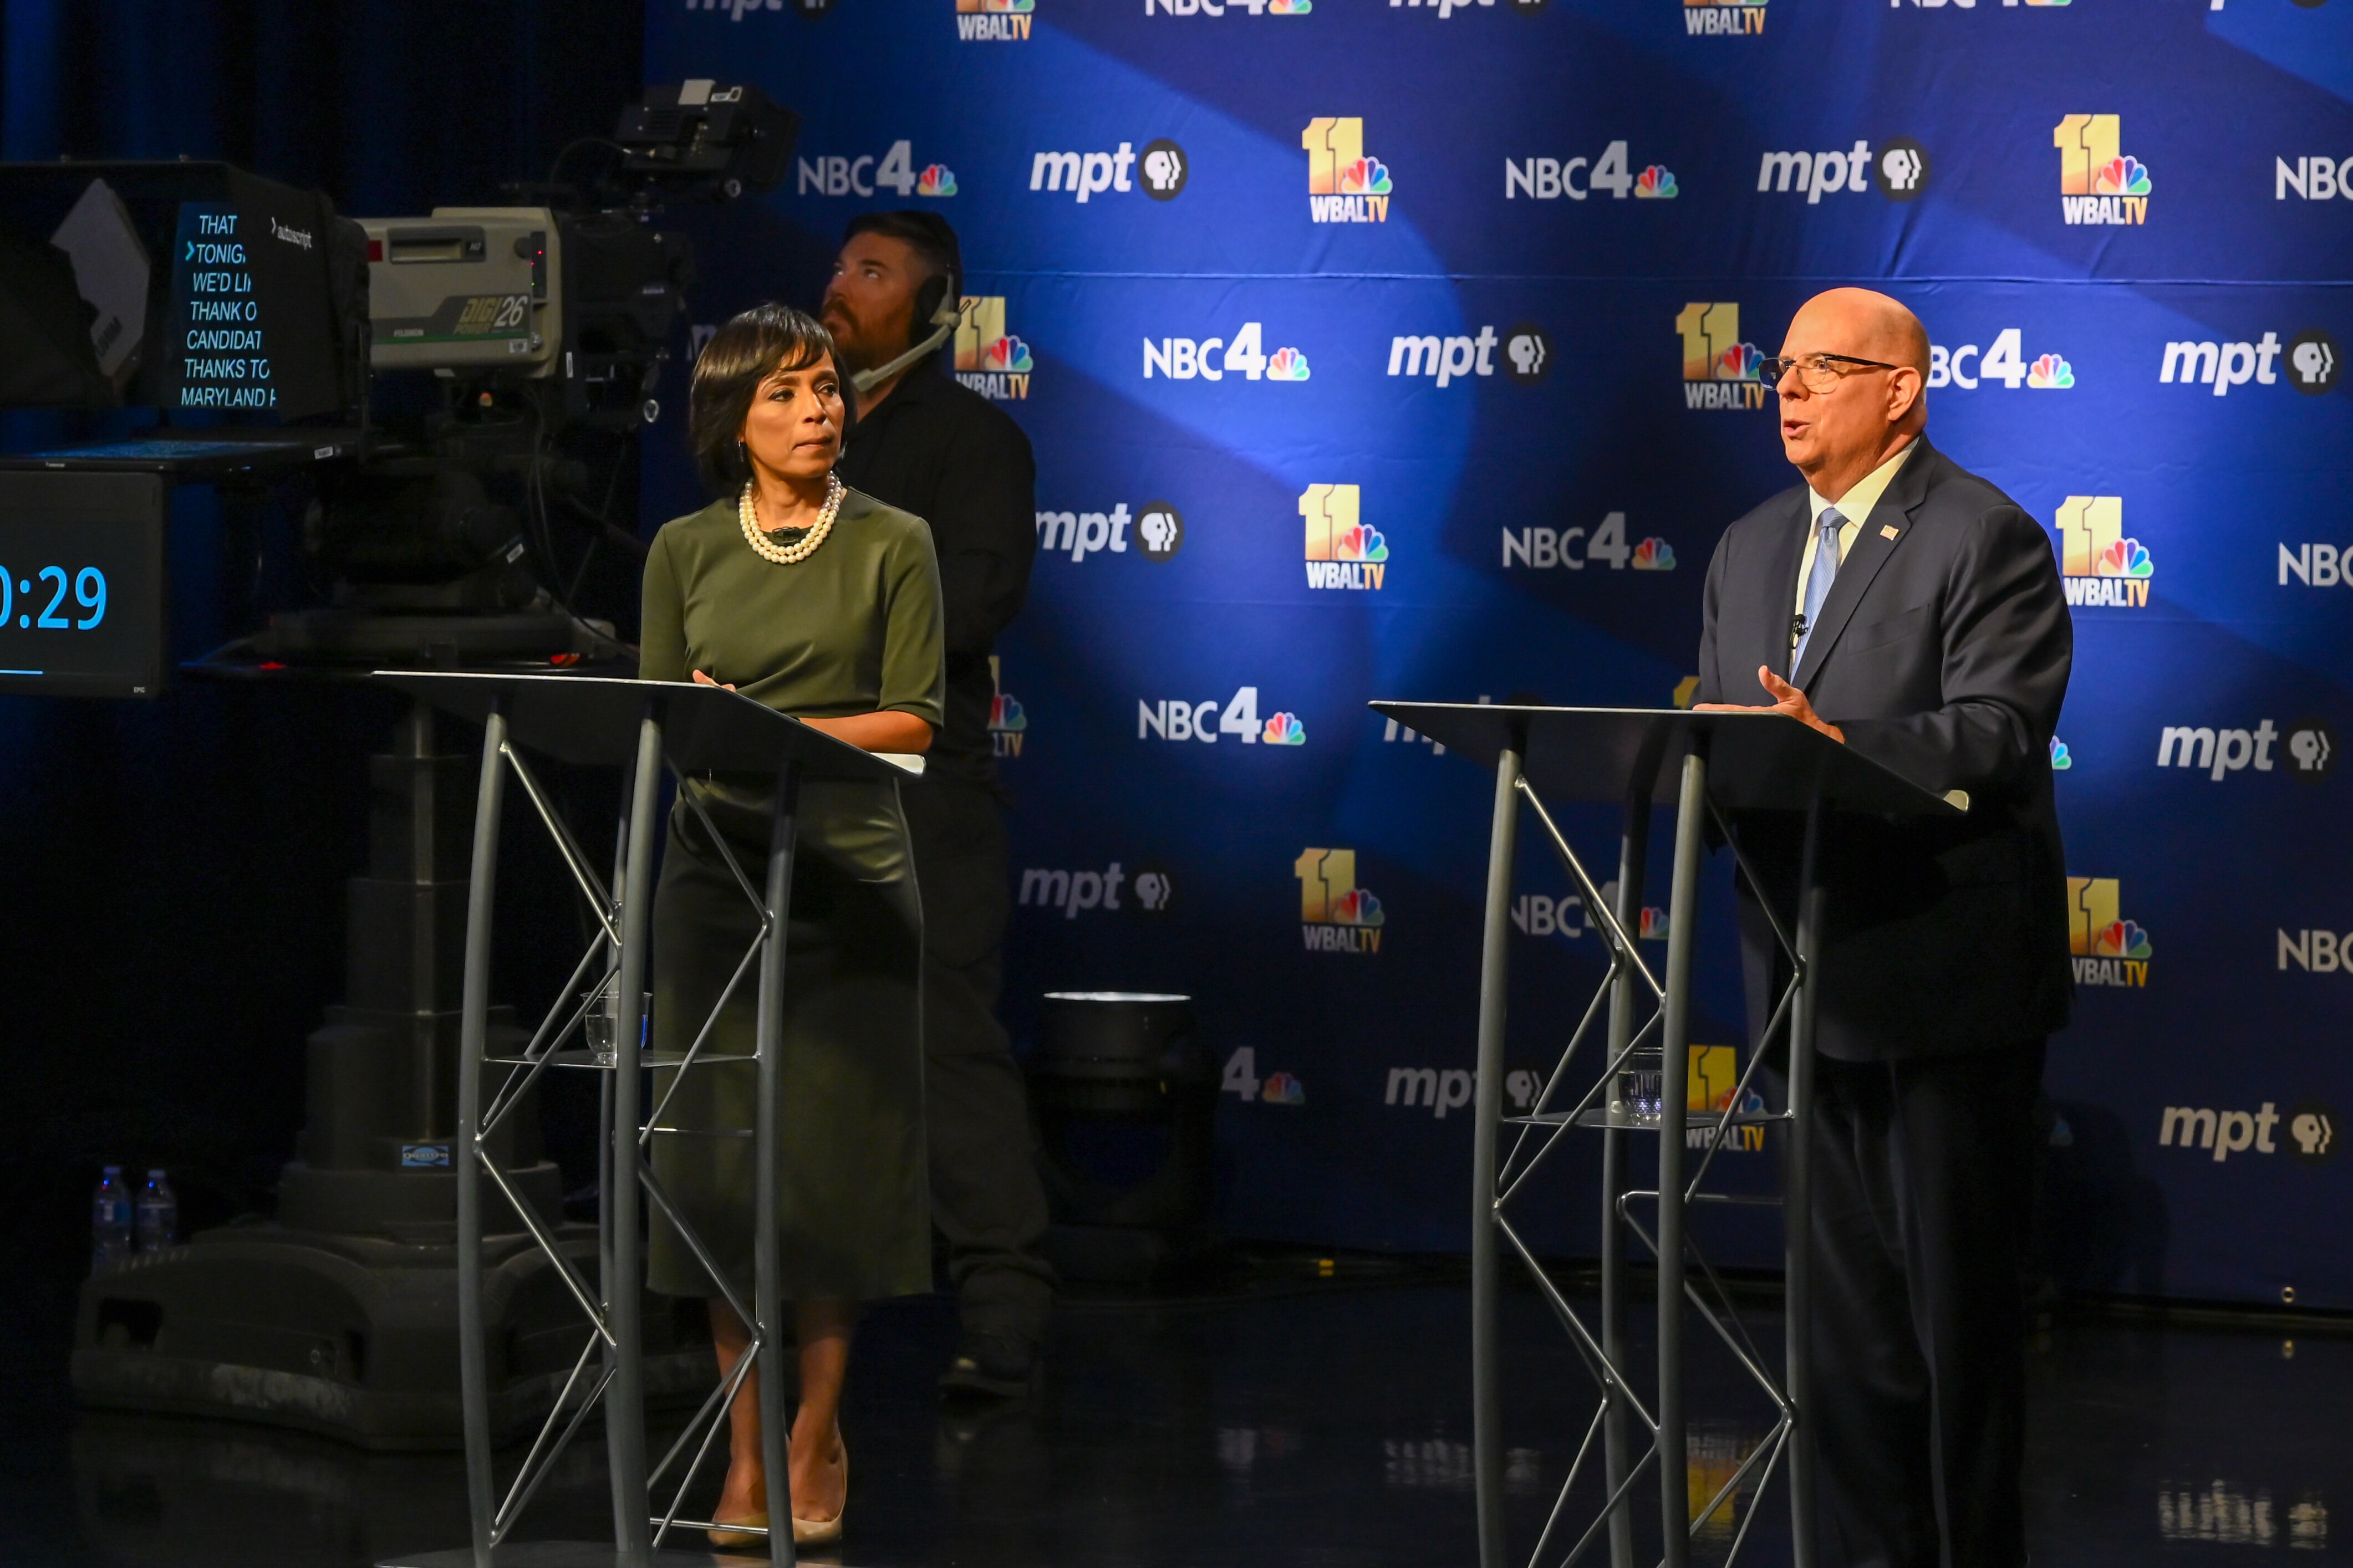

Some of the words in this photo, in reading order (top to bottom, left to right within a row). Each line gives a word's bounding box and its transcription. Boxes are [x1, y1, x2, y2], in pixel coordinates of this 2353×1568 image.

[798, 140, 916, 198] NBC4
[1030, 142, 1135, 203] mpt
[1506, 140, 1632, 200] NBC4
[1757, 140, 1872, 205] mpt
[199, 214, 238, 234] THAT
[1310, 195, 1389, 223] WBALTV
[2062, 196, 2148, 225] WBALTV
[190, 301, 242, 321] THANK
[193, 272, 231, 293] WE'D
[235, 272, 252, 293] LI
[493, 295, 528, 327] 26
[186, 329, 263, 350] CANDIDAT
[1143, 322, 1267, 381] NBC4
[1387, 326, 1498, 388] mpt
[1926, 328, 2026, 390] BC4
[2160, 332, 2281, 396] mpt
[181, 387, 266, 407] MARYLAND
[184, 359, 246, 379] THANKS
[1035, 503, 1132, 563] mpt
[1502, 511, 1632, 570] NBC4
[1305, 561, 1385, 590] WBALTV
[1138, 686, 1262, 744] NBC4
[2156, 719, 2278, 782] mpt
[1018, 862, 1125, 919] mpt
[1302, 924, 1382, 954] WBALTV
[1385, 1067, 1478, 1118] mp
[2158, 1102, 2280, 1162] mpt
